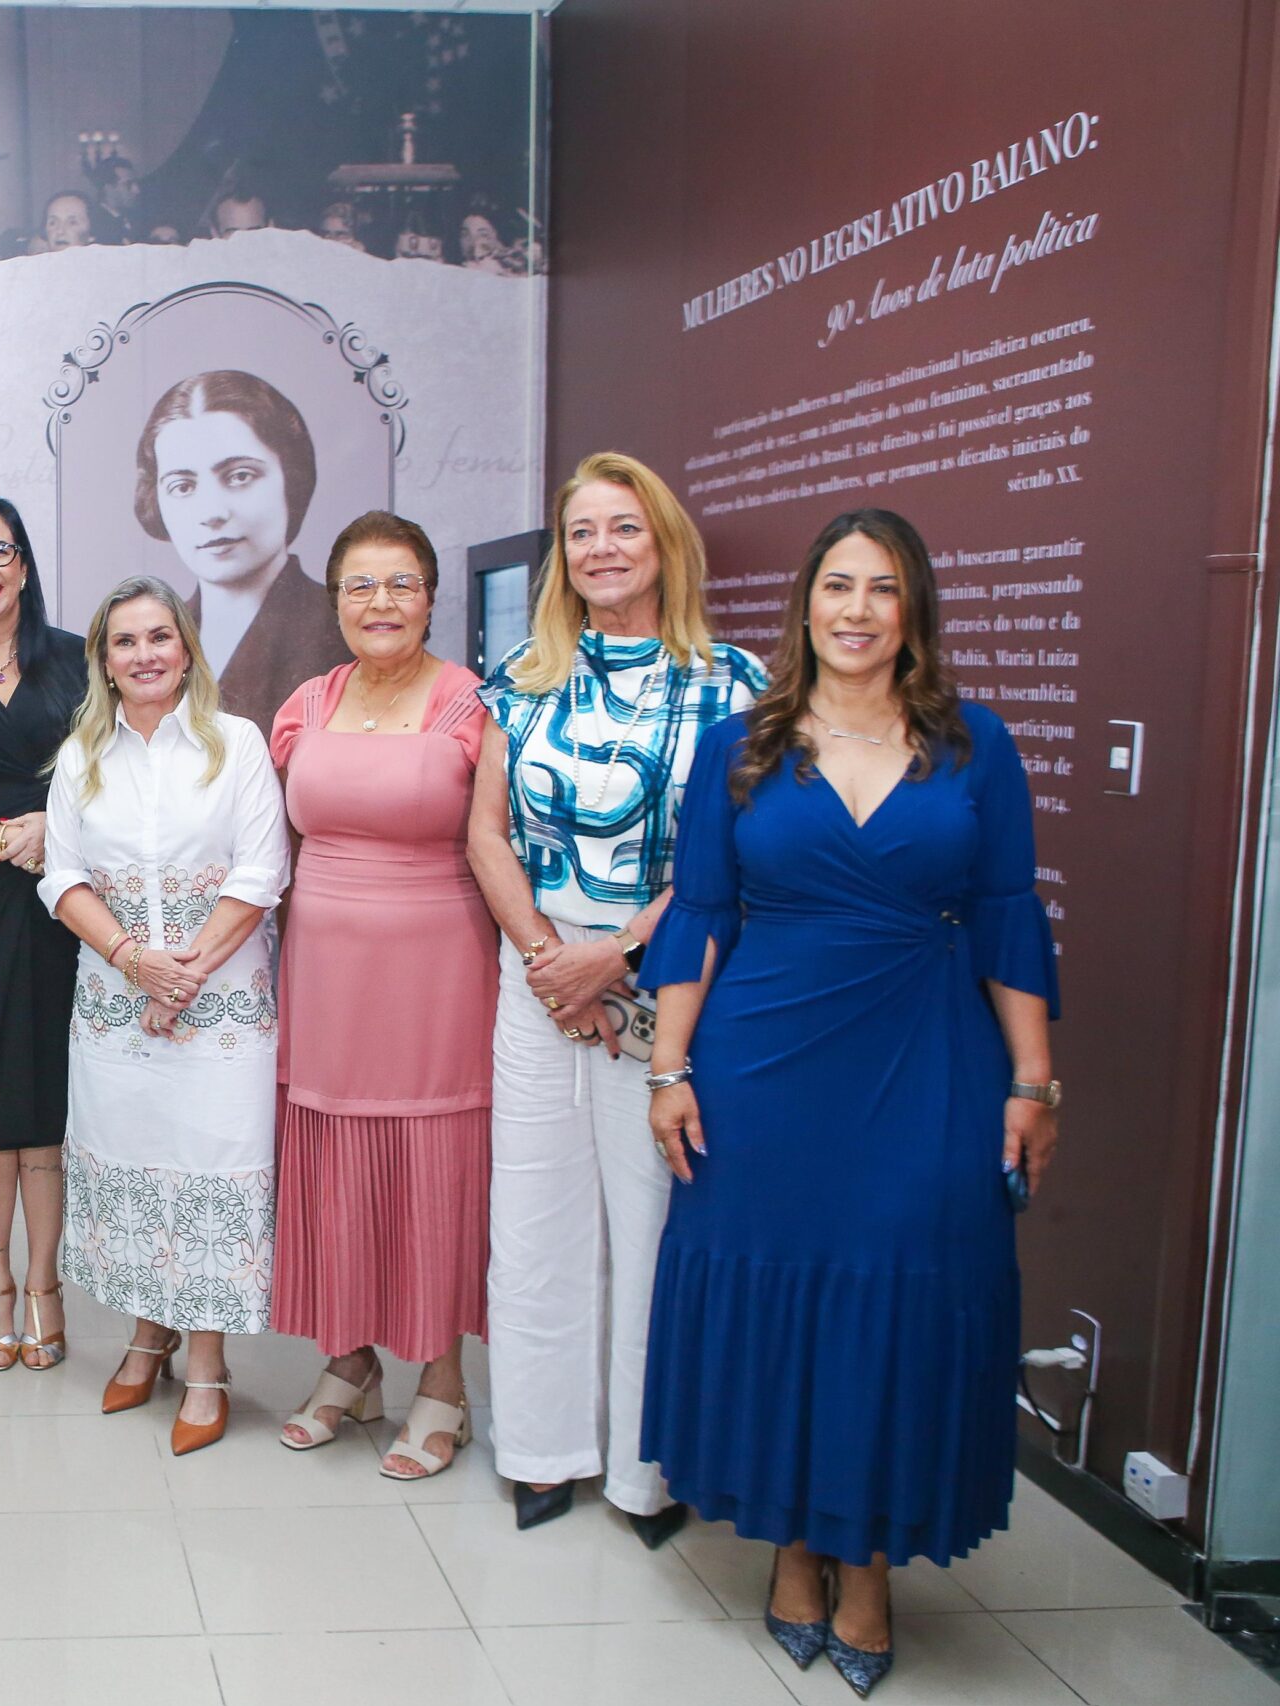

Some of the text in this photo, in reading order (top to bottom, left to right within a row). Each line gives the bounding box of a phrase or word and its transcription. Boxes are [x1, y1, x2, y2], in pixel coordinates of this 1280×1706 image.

[682, 111, 1100, 331] MULHERES NO LEGISLATIVO BAIANO:
[818, 211, 1100, 348] 90 Anos de luta política
[886, 351, 960, 390] institucional
[962, 335, 1027, 366] brasileira
[993, 350, 1094, 392] sacramentado
[1014, 399, 1062, 424] graças
[1065, 391, 1093, 410] aos
[940, 456, 955, 471] as
[957, 443, 1009, 467] décadas
[1012, 431, 1066, 456] iniciais
[1070, 425, 1090, 446] do
[1007, 468, 1054, 492] século
[957, 537, 1086, 567] buscaram garantir
[936, 574, 1083, 601] eminina, perpassando
[944, 611, 1081, 633] através do voto e da
[995, 648, 1034, 667] Maria
[1038, 648, 1080, 667] Luiza
[978, 686, 995, 700] na
[999, 683, 1077, 703] Assembleia
[1054, 756, 1073, 776] de
